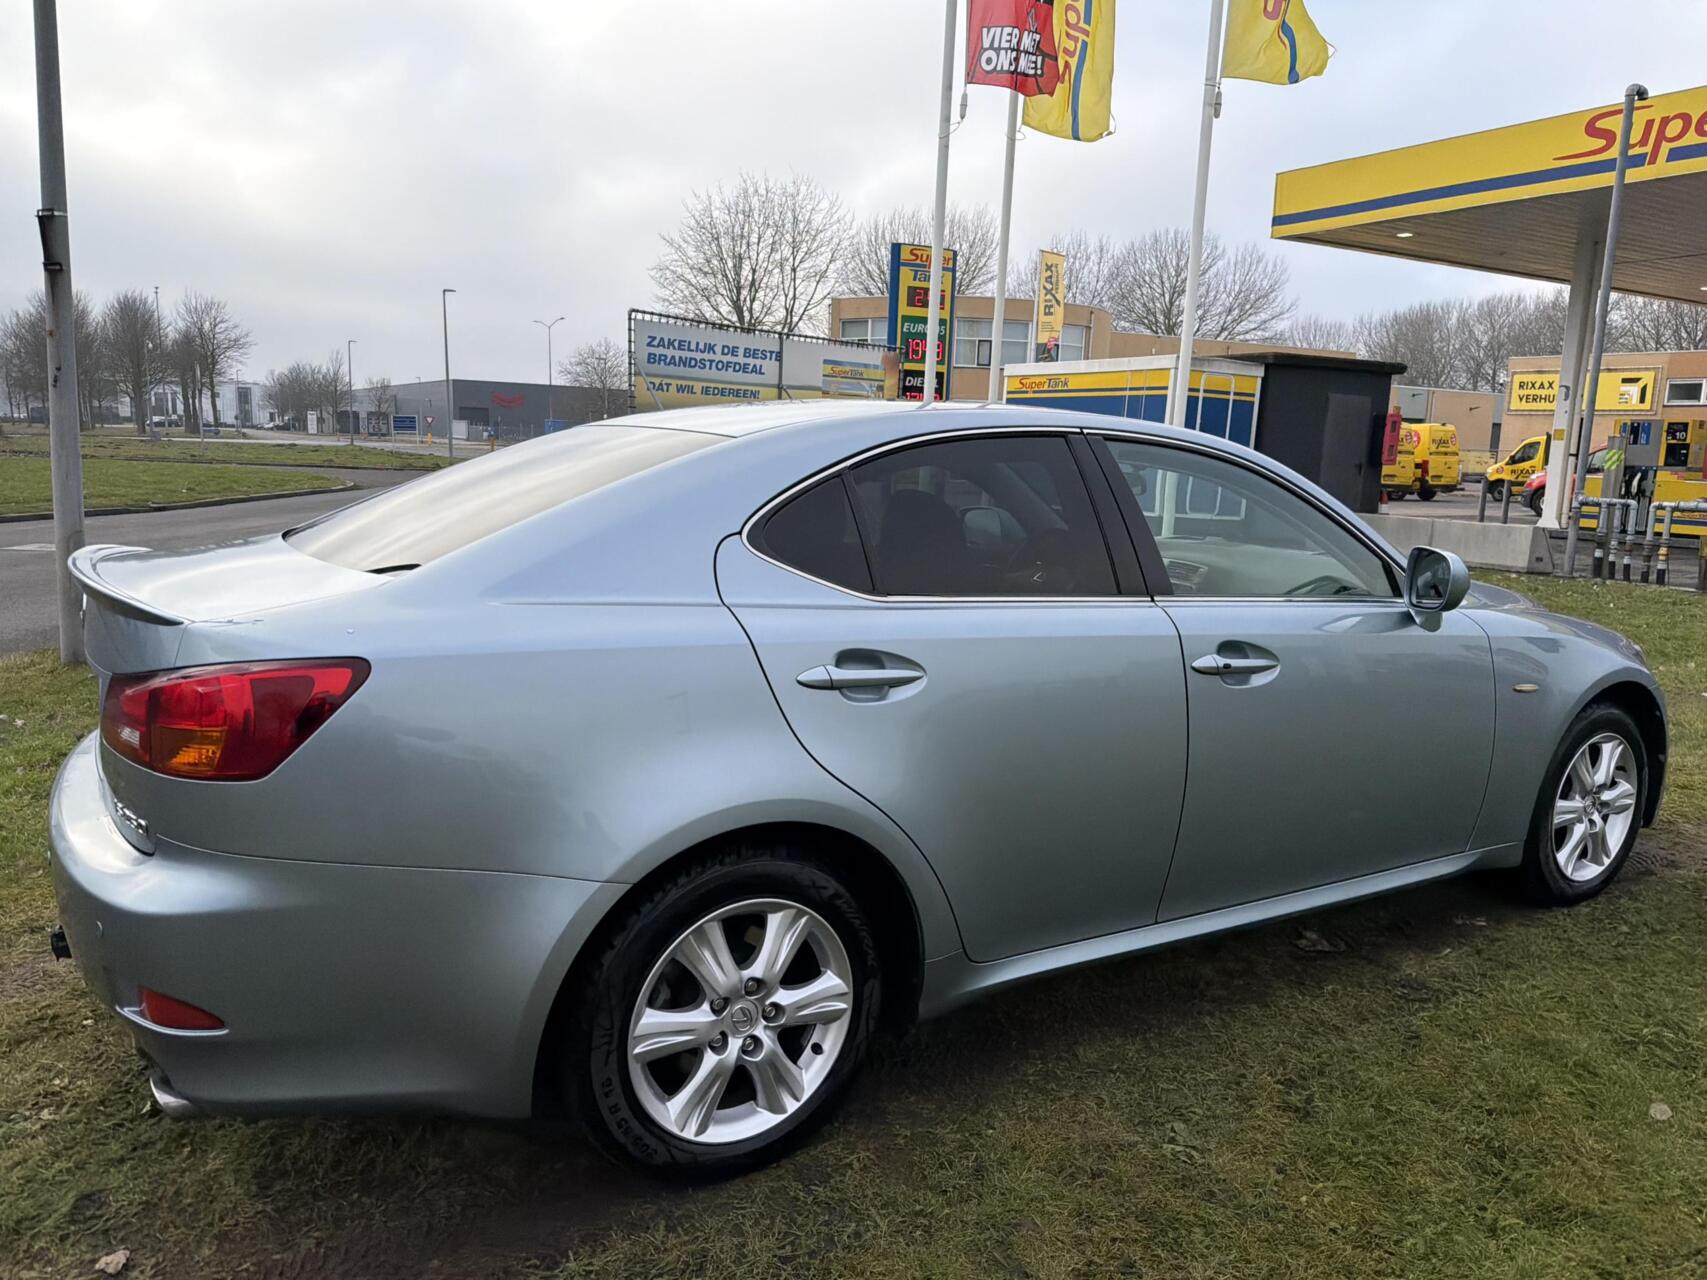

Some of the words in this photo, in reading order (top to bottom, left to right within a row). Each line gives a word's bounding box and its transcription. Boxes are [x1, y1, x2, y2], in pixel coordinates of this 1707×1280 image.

[982, 26, 1019, 49] VIER
[1020, 30, 1041, 53] MET
[979, 49, 1017, 71] ONS
[1043, 262, 1061, 316] RIXAX
[646, 335, 717, 355] ZAKELIJK
[721, 344, 739, 357] DE
[743, 347, 781, 362] BESTE
[647, 352, 765, 375] BRANDSTOFDEAL
[676, 383, 697, 395] WIL
[701, 386, 760, 399] IEDEREEN!
[1013, 376, 1070, 395] SuperTank
[1518, 380, 1555, 390] RIXAX
[1518, 394, 1556, 404] VERHU
